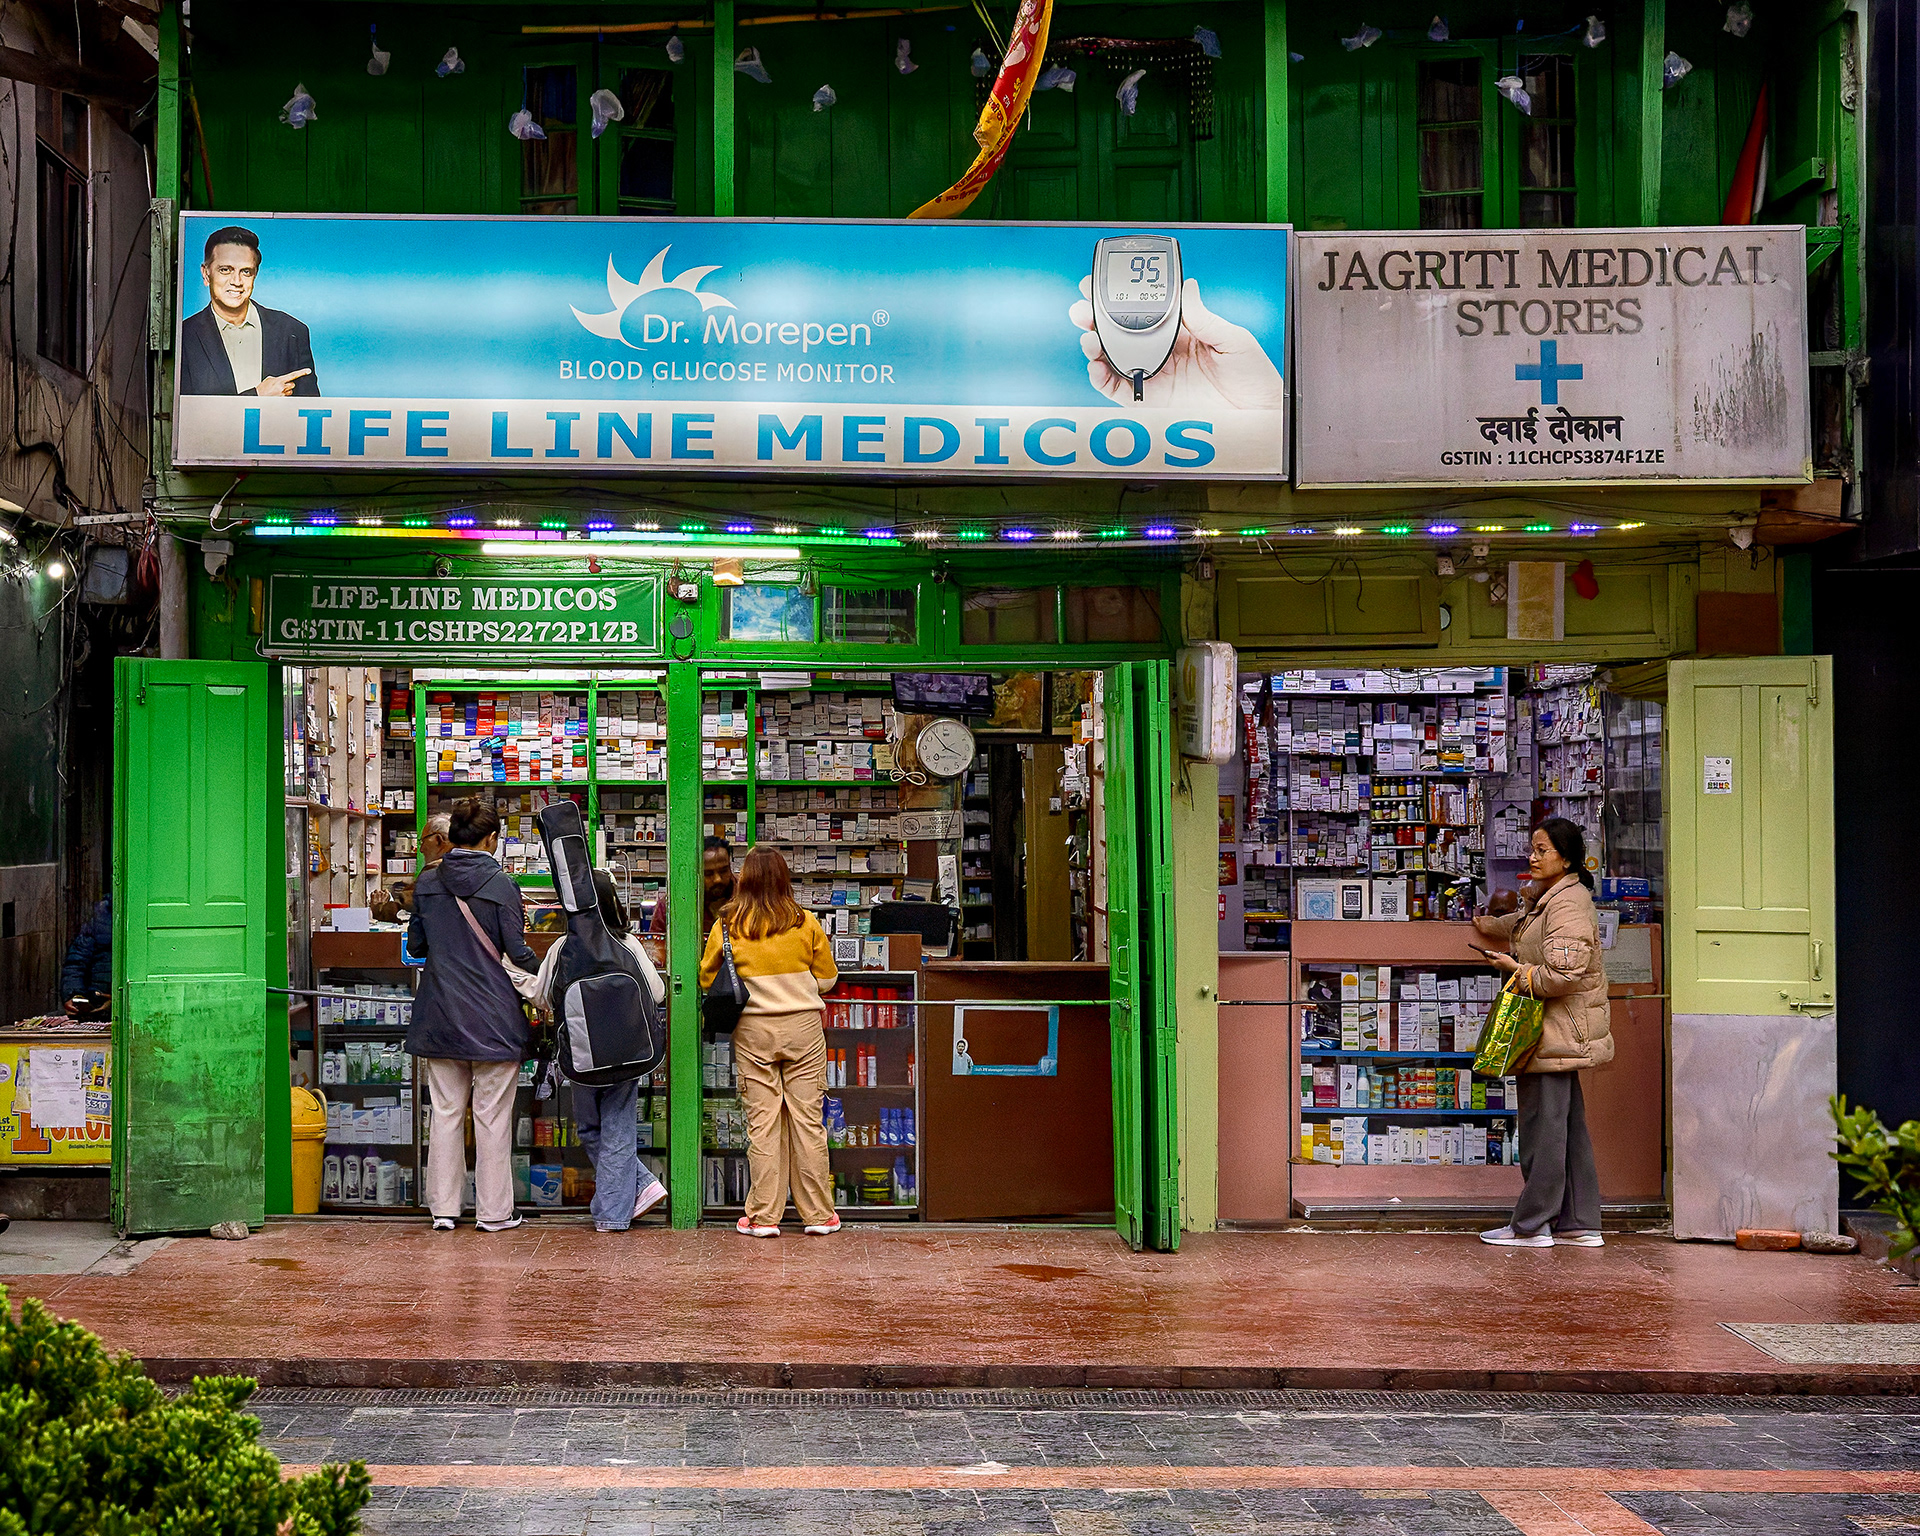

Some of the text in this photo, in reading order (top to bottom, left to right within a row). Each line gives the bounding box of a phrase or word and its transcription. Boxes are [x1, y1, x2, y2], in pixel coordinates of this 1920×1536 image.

[1130, 256, 1160, 283] 95
[1317, 250, 1519, 291] JAGRITI
[643, 314, 690, 345] Dr.
[1455, 298, 1644, 336] STORES
[559, 360, 896, 384] BLOOD GLUCOSE MONITOR
[242, 408, 1217, 468] LIFE LINE MEDICOS
[1475, 406, 1625, 446] दवाई दोकान
[1440, 450, 1495, 466] GSTIN
[1507, 448, 1665, 466] 11CHCPS3874F1ZE
[311, 585, 618, 612] LIFE-LINE MEDICOS
[280, 617, 639, 643] GSTIN-11CSHPS2272P1ZB
